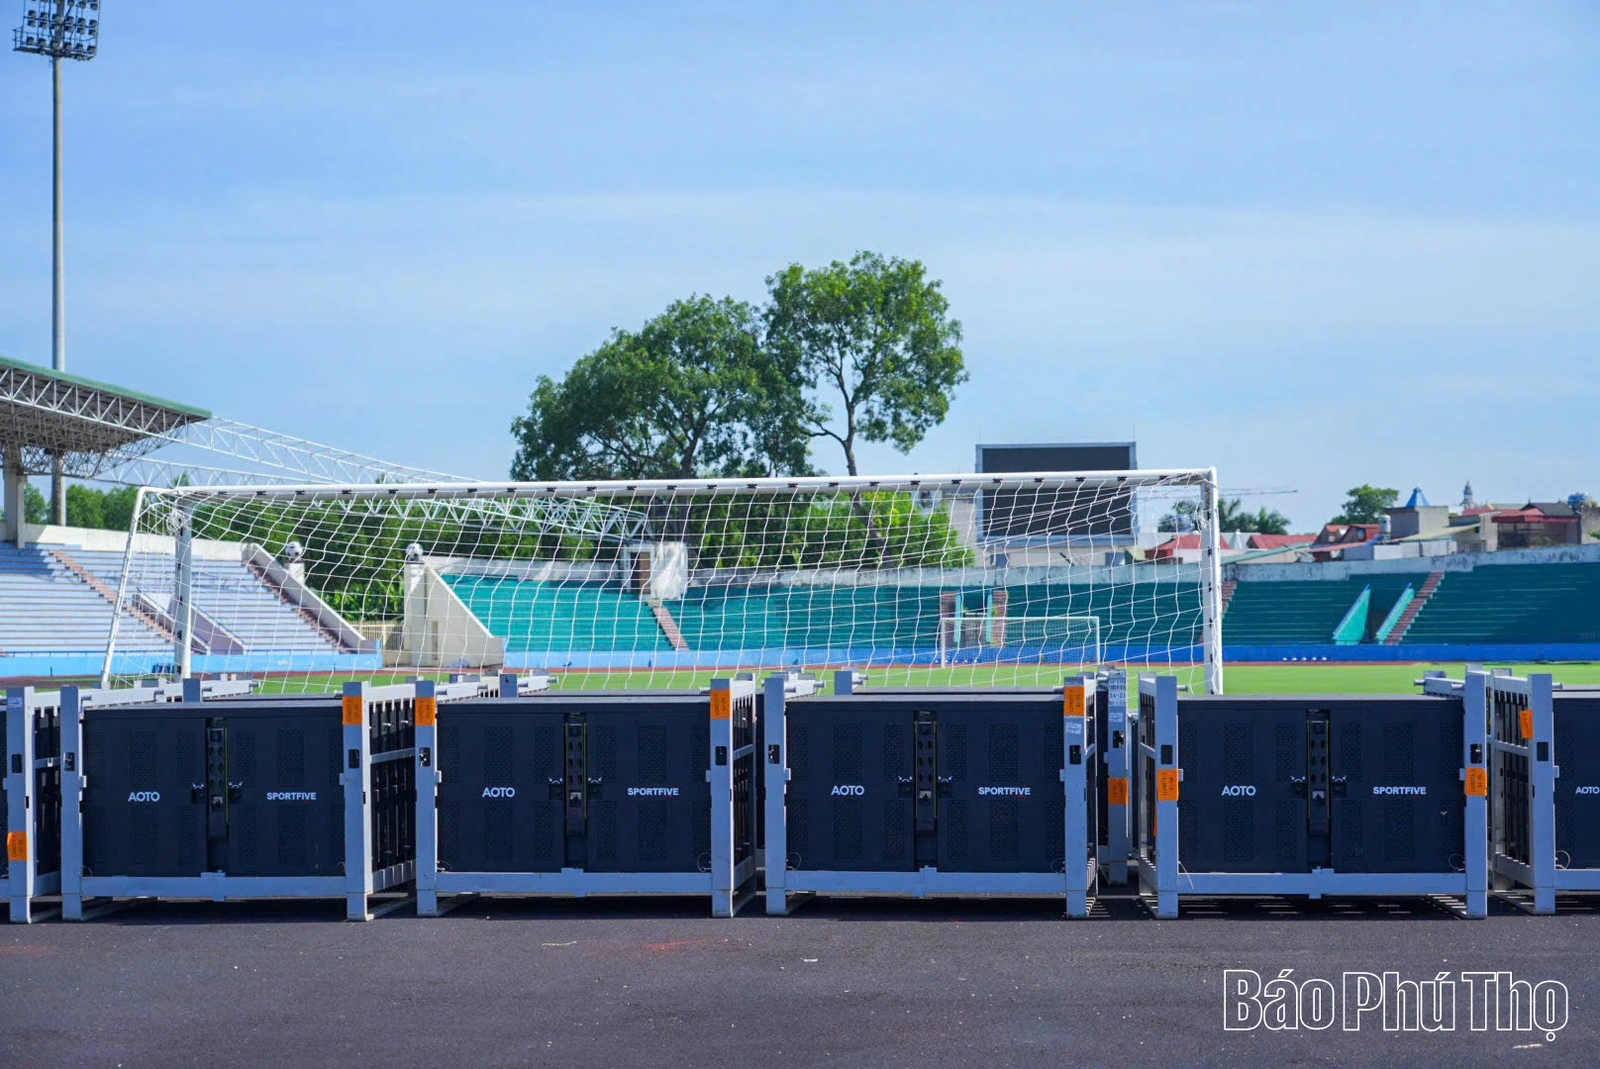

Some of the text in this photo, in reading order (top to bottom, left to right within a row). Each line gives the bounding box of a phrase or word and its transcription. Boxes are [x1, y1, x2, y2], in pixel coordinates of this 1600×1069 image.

[481, 786, 516, 798] AOTO
[627, 787, 679, 796] SPORTFIVE
[830, 784, 865, 796] AOTO
[978, 786, 1031, 796] SPORTFIVE
[1221, 785, 1257, 797] AOTO
[1372, 786, 1427, 796] SPORTFIVE
[1575, 786, 1600, 795] AOTO
[127, 791, 161, 802] AOTO
[266, 791, 317, 801] SPORTFIVE
